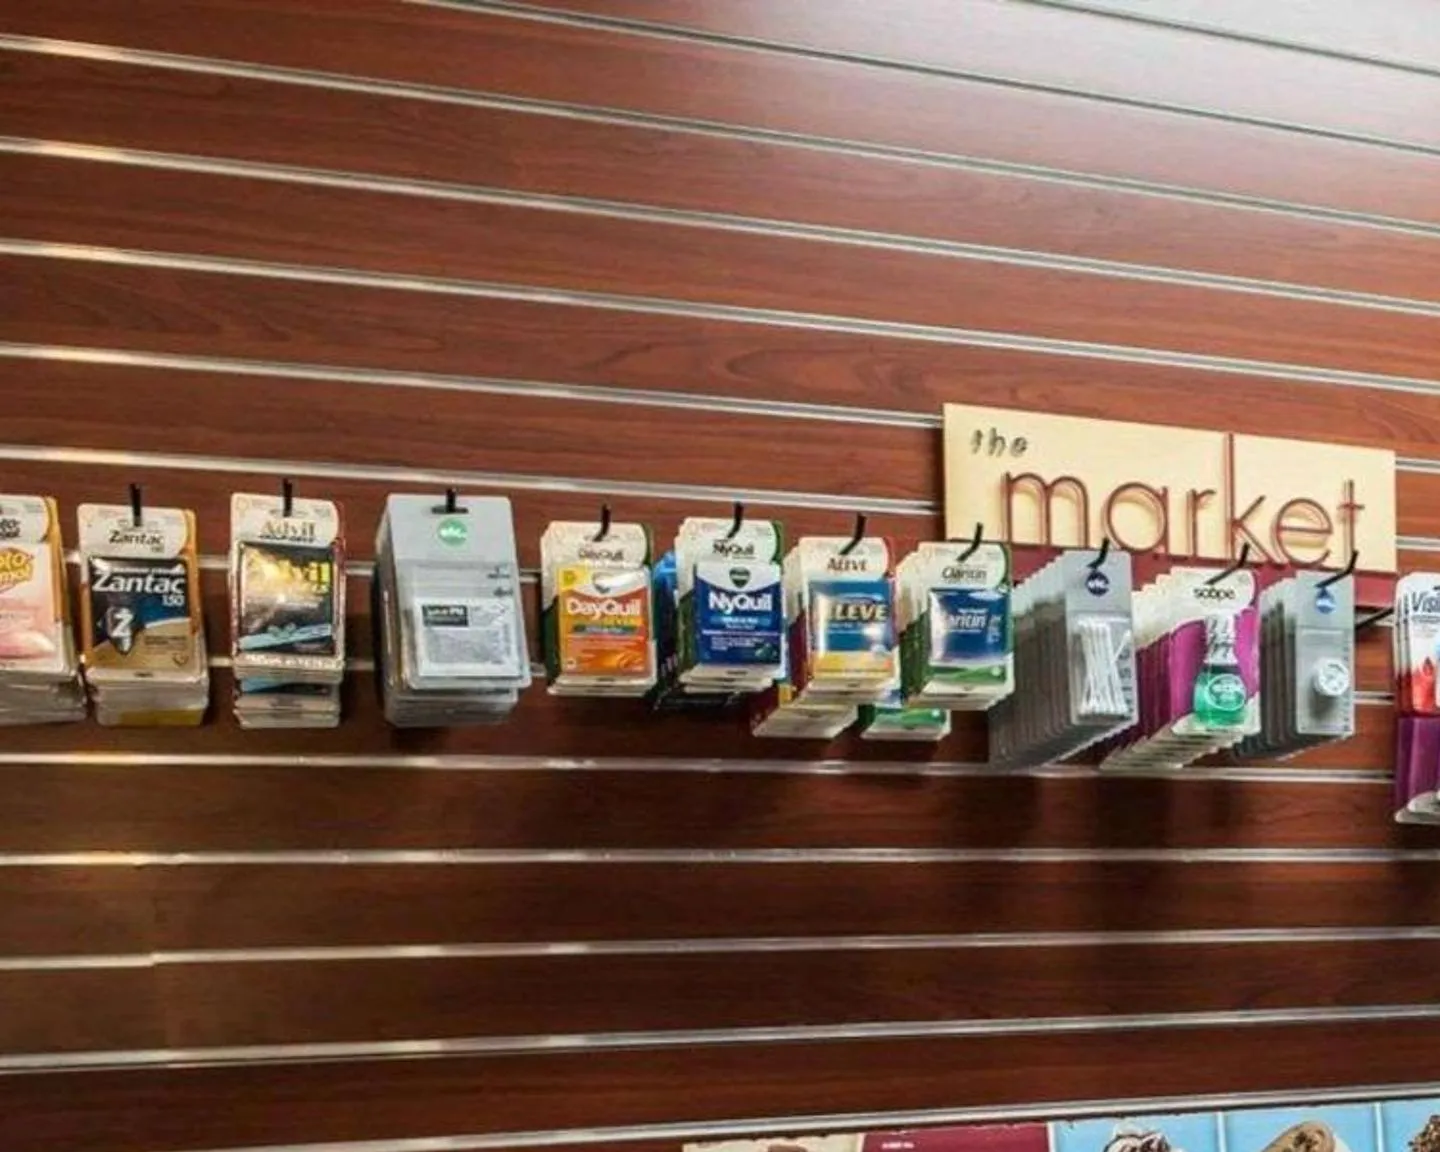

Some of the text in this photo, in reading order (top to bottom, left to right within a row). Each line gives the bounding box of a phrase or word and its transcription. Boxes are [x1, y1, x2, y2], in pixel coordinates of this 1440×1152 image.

[971, 427, 1029, 457] the
[1001, 432, 1365, 566] market
[108, 529, 164, 545] Zantac
[91, 568, 185, 594] Zantac
[942, 566, 988, 579] Claritin
[162, 593, 185, 607] 150
[708, 591, 773, 615] NyQuil
[1192, 587, 1237, 602] scope
[566, 597, 642, 621] DayQuil
